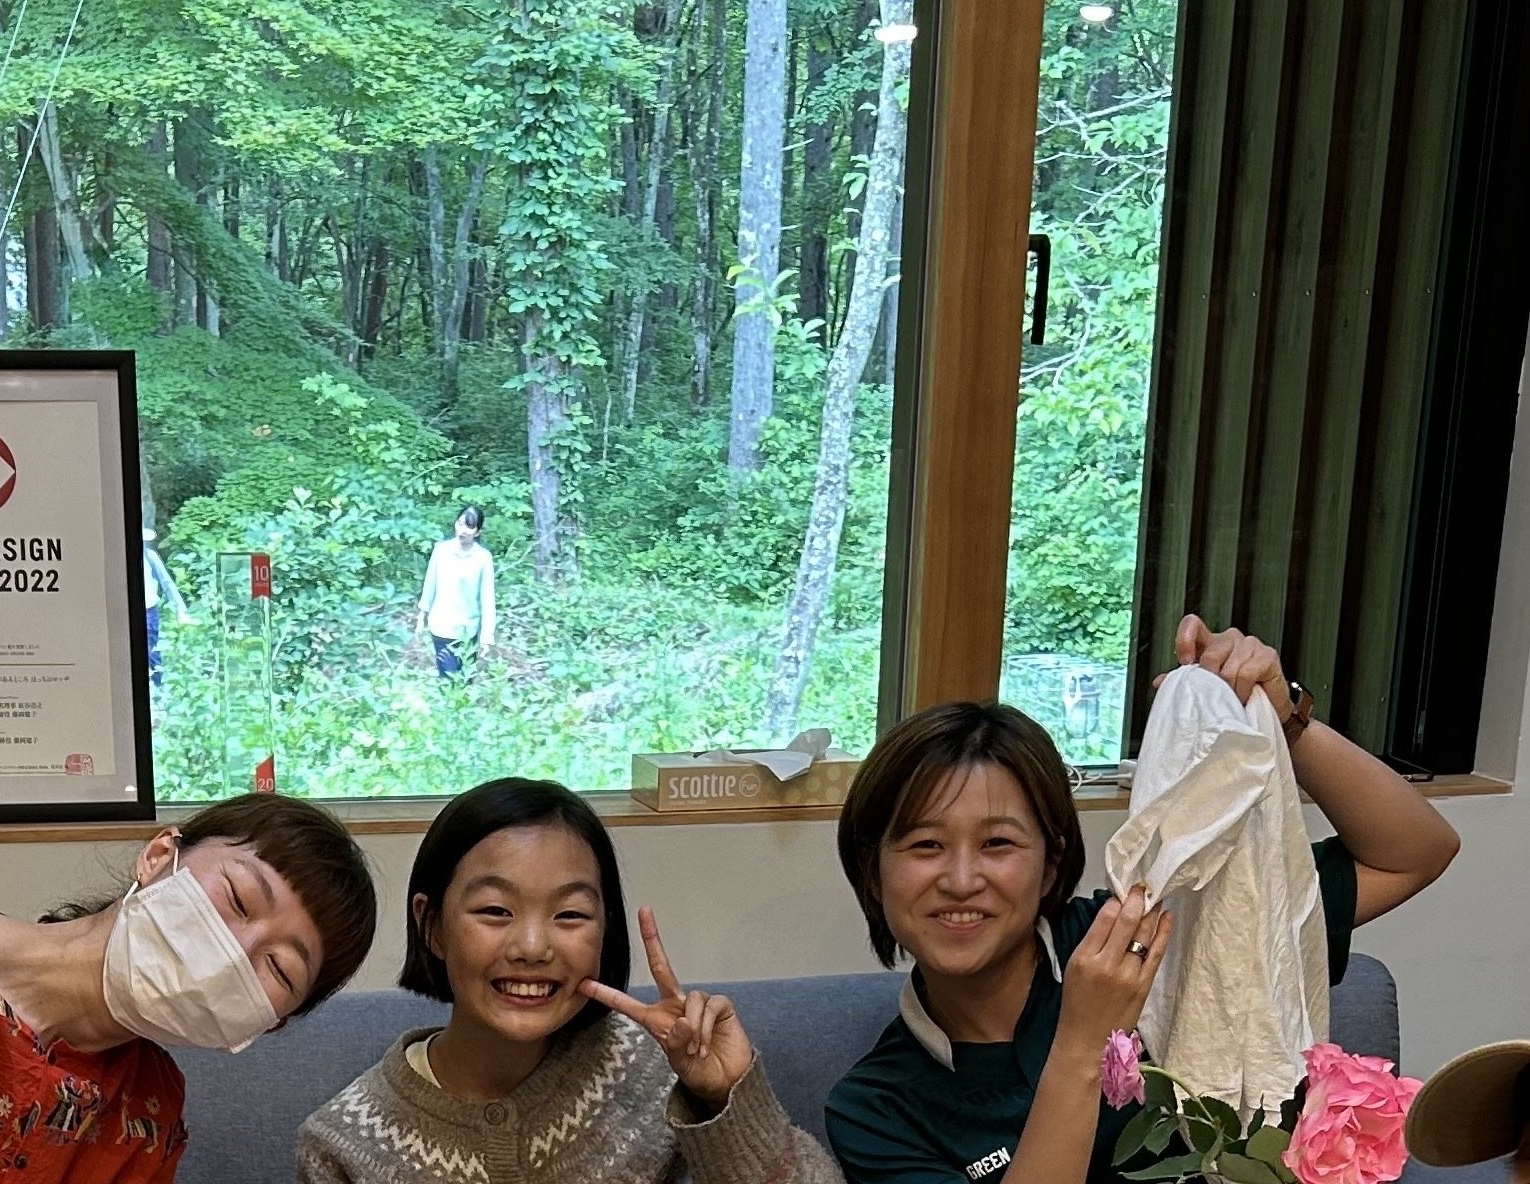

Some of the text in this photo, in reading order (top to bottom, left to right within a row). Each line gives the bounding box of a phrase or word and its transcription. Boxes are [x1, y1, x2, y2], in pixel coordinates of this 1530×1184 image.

[253, 565, 269, 581] 10
[257, 778, 274, 791] 20
[965, 1146, 1011, 1180] GREEN
